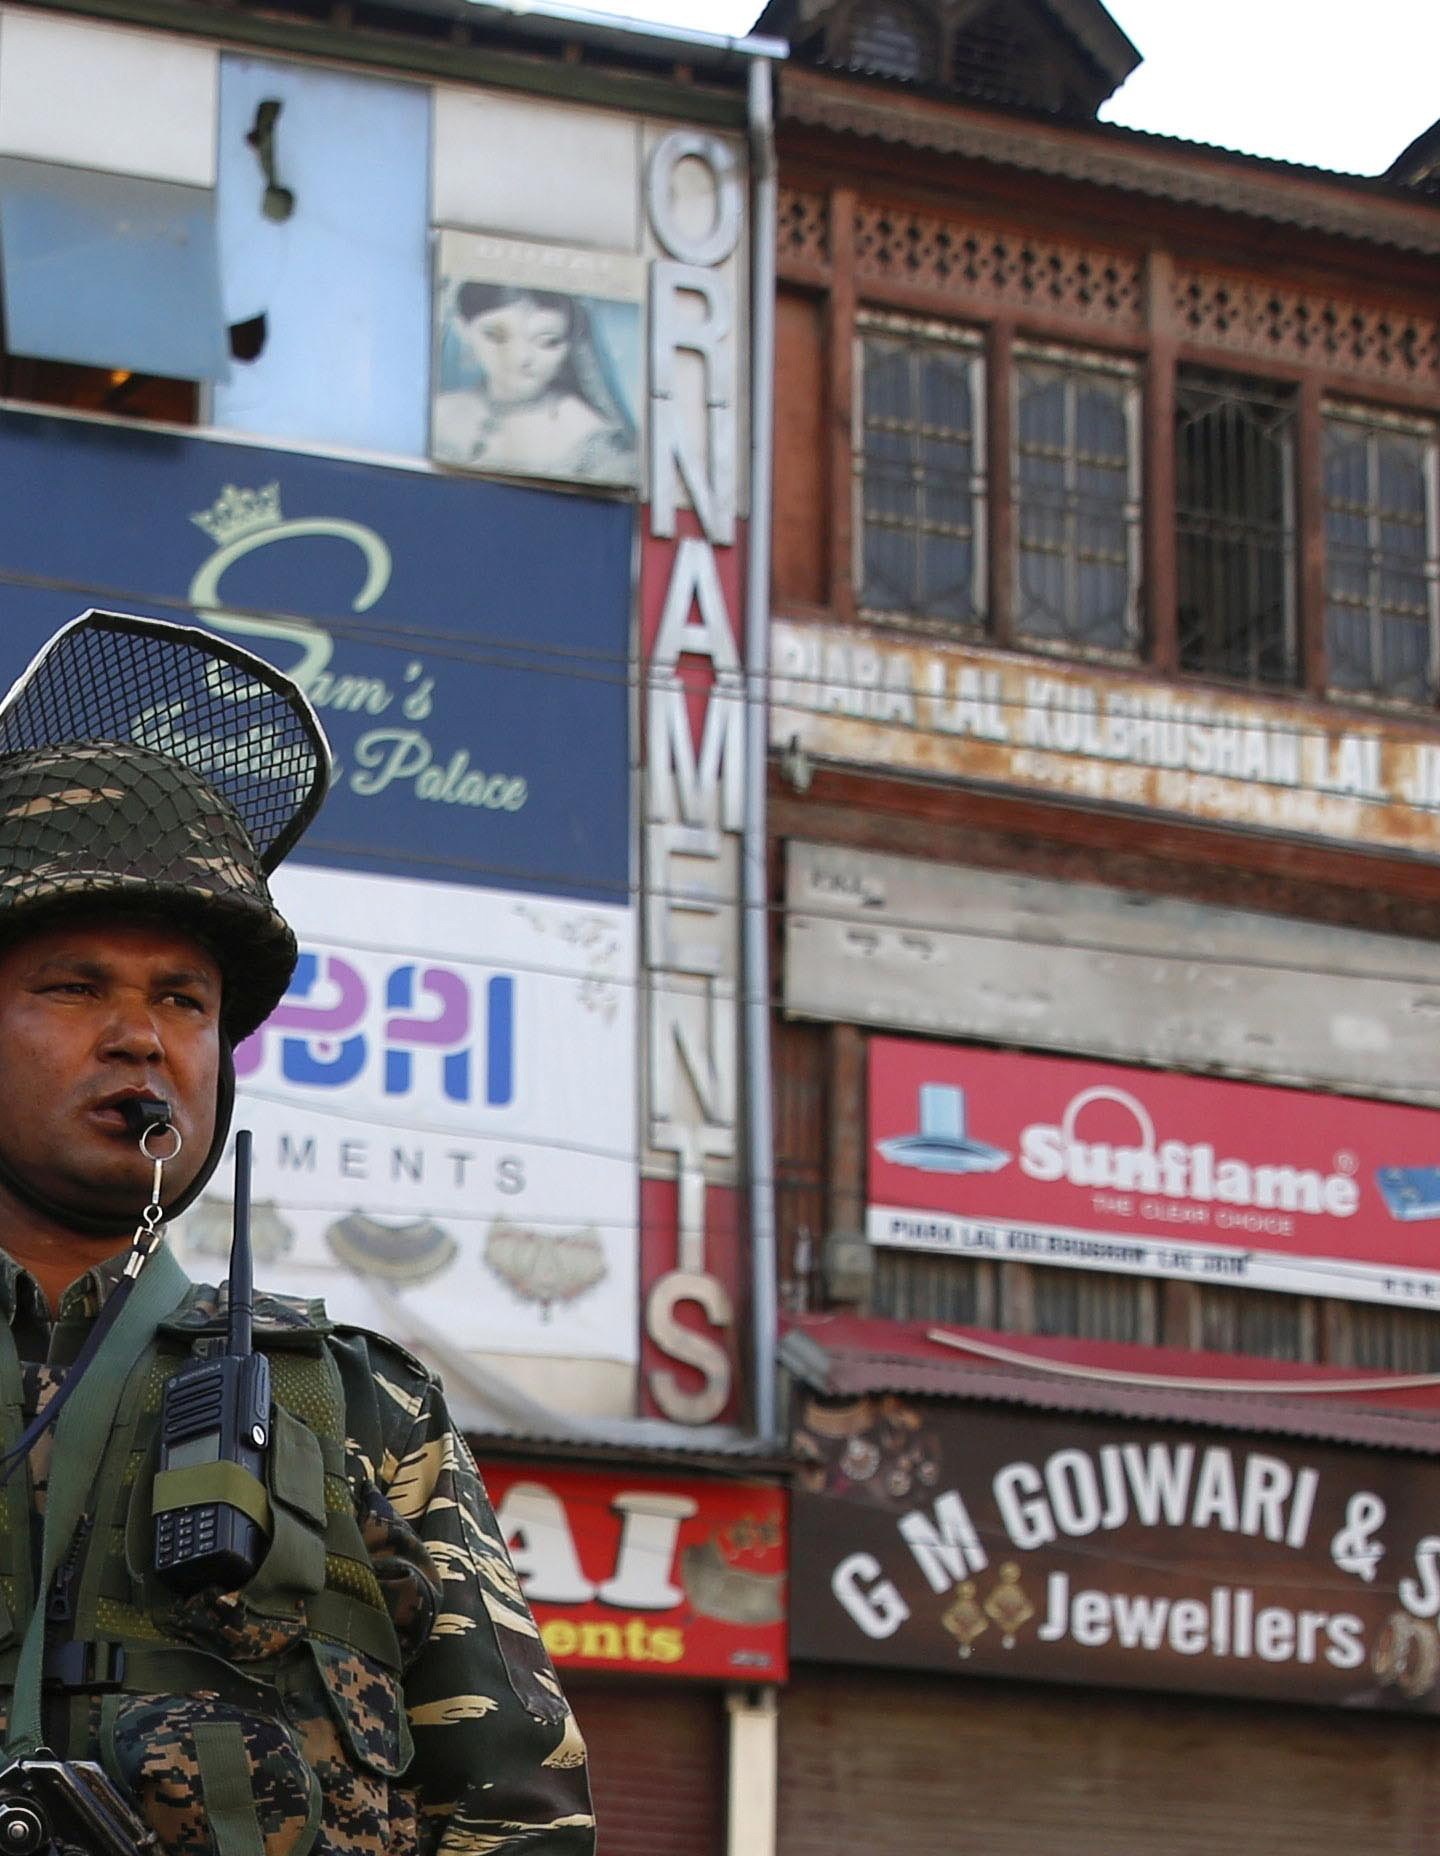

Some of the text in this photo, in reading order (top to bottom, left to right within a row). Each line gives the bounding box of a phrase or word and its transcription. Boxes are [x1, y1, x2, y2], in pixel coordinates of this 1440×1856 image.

[351, 726, 528, 813] Palace
[646, 128, 744, 1424] ORNAMENTS
[926, 659, 1009, 743] LAL
[1317, 730, 1388, 801] LAL
[1020, 1120, 1361, 1218] Sunflame
[831, 1553, 911, 1641] G
[899, 1490, 989, 1594] M
[992, 1441, 1321, 1553] GOJWARI
[1331, 1492, 1387, 1583] &
[1039, 1571, 1366, 1669] Jewellers
